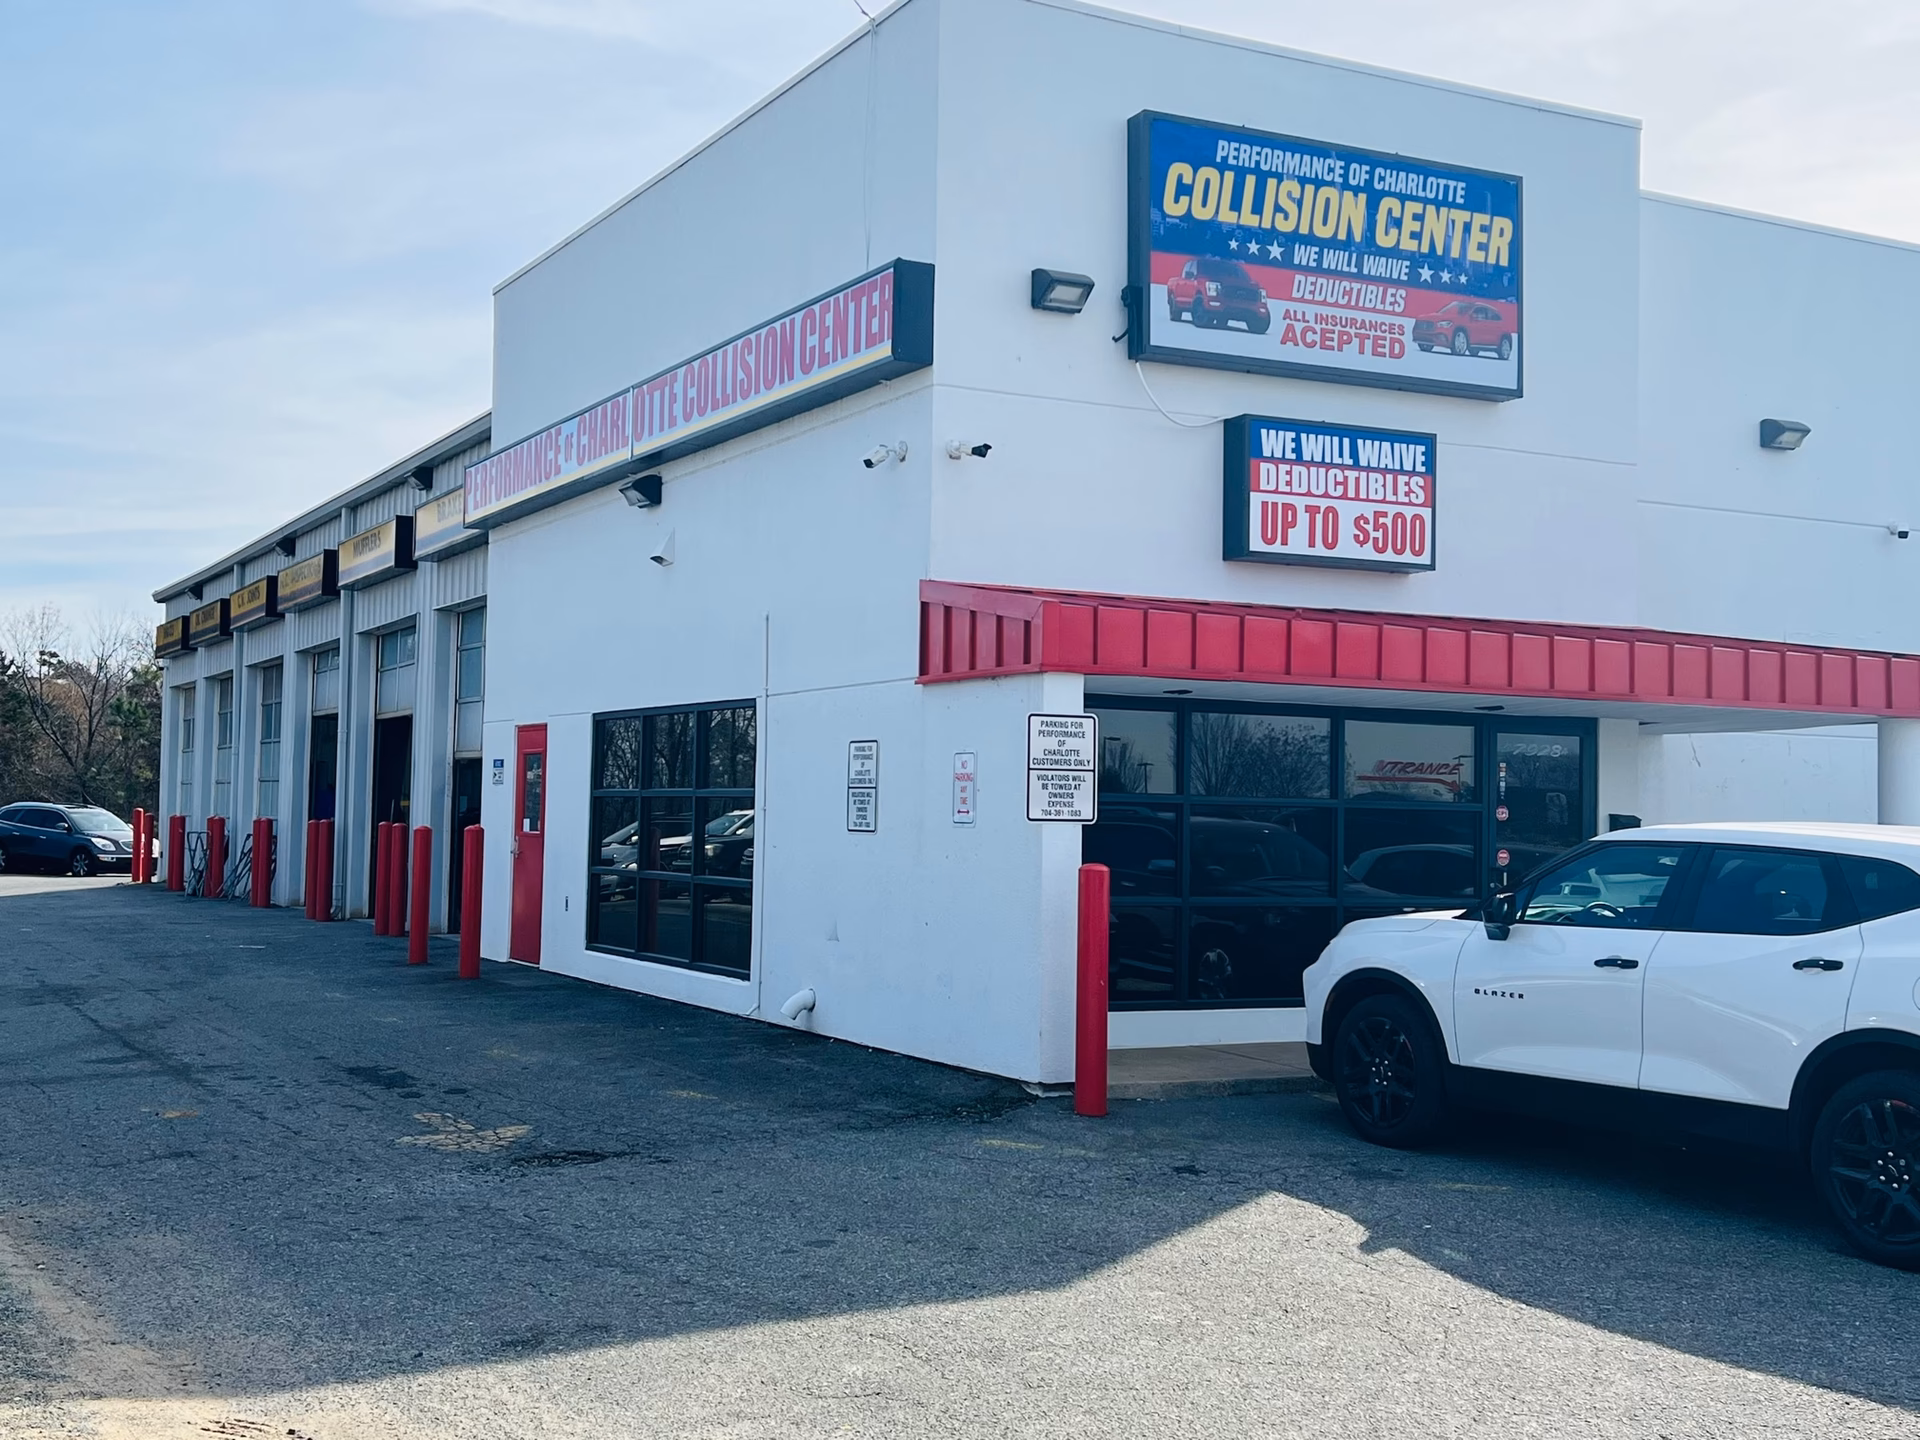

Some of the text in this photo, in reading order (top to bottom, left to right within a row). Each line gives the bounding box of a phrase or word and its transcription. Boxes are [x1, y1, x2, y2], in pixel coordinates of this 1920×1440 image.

[1216, 139, 1466, 204] PERFORMANCE OF CHARLOTTE
[1162, 161, 1514, 267] COLLISION CENTER
[1293, 243, 1411, 281] WE WILL WAIVE
[1291, 273, 1407, 313] DEDUCTIBLES
[1282, 308, 1406, 336] ALL INSURANCES
[1280, 322, 1406, 360] ACEPTED
[465, 270, 894, 515] PERFORMANCE OF CHARLOTTE COLLISION CENTER
[1260, 428, 1426, 473] WE WILL WAIVE
[1259, 462, 1426, 505] DEDUCTIBLES
[1260, 501, 1426, 557] UP TO $500
[353, 529, 382, 560] MUFFLERS
[1040, 720, 1084, 729] PARKING FOR
[1038, 729, 1086, 739] PERFORMANCE
[1057, 739, 1066, 748] OF
[1513, 743, 1562, 757] 7928
[1043, 748, 1081, 757] CHARLOTTE
[961, 760, 968, 769] NO
[1032, 757, 1092, 767] CUSTOMERS ONLY
[955, 772, 973, 782] PARKING
[1036, 774, 1087, 783] VIOLATORS WILL
[1050, 783, 1073, 791] TOWED
[1048, 791, 1075, 800] OWNERS
[1047, 800, 1075, 809] EXPENSE
[1474, 988, 1524, 1000] BLAZER
